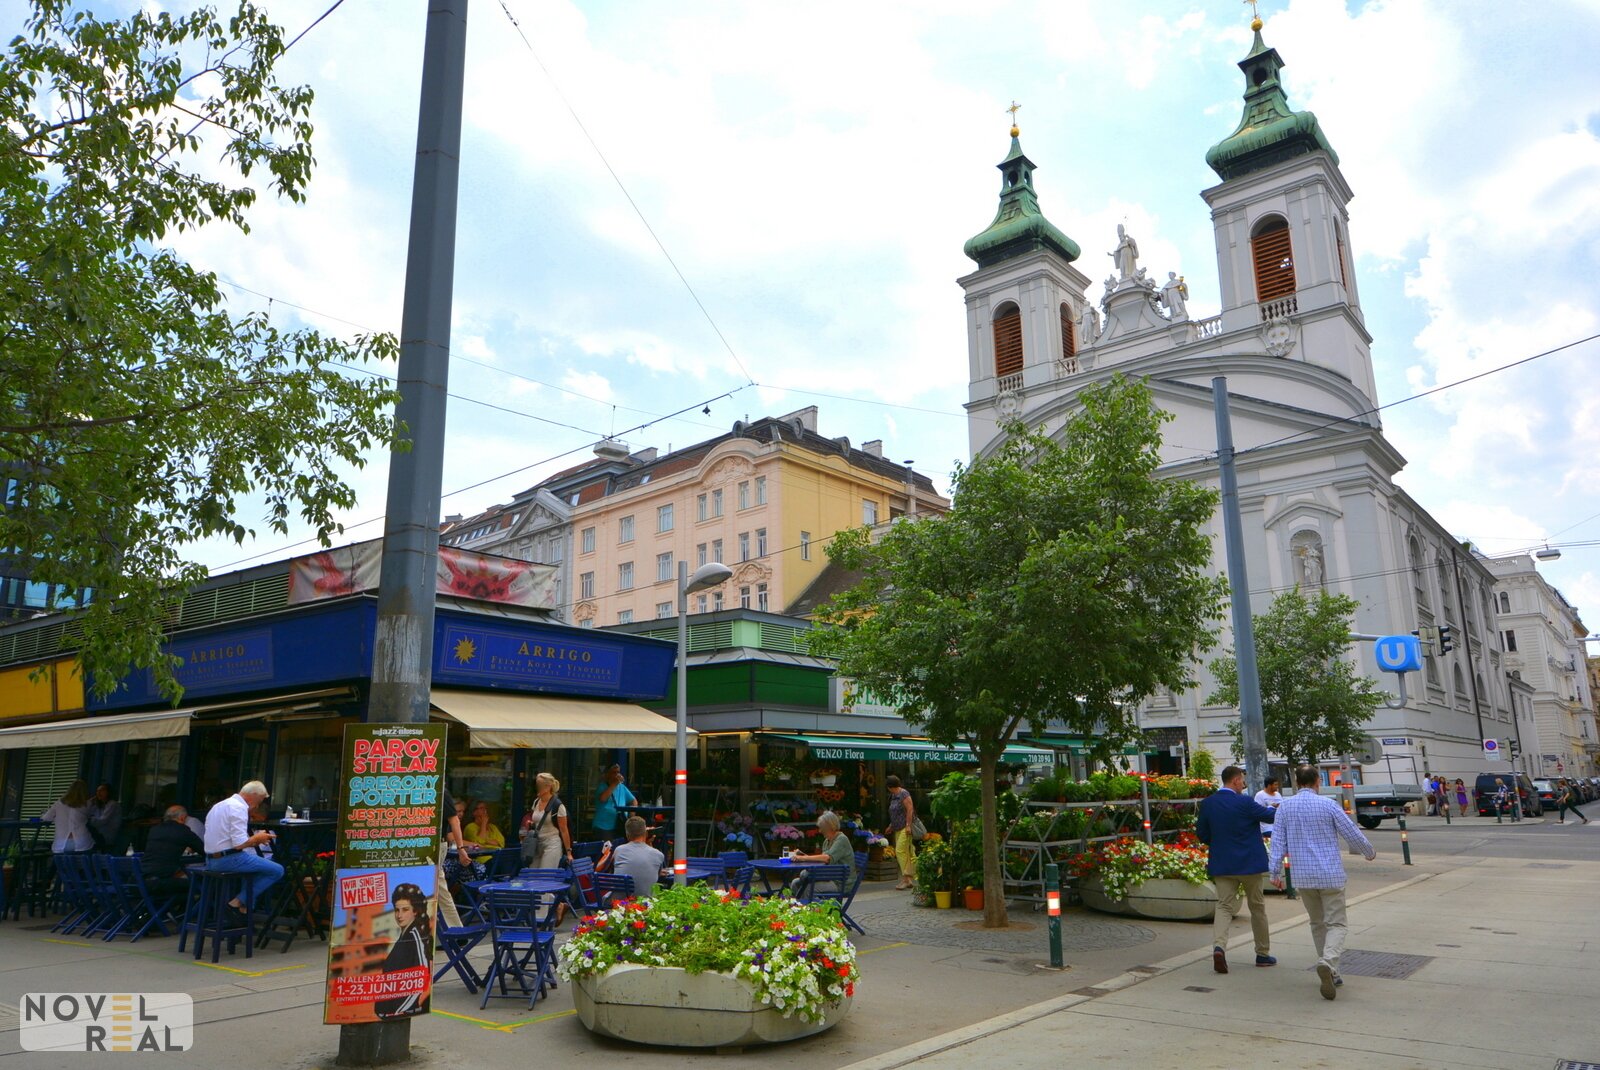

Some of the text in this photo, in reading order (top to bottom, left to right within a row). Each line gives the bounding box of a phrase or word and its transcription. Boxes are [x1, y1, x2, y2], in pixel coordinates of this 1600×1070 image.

[191, 644, 245, 664] ARRIGO
[518, 641, 592, 663] ARRIGO
[1380, 642, 1406, 666] U
[354, 738, 440, 758] PAROV
[816, 748, 865, 760] PENZO Flora
[924, 751, 941, 761] FÜR
[944, 753, 964, 761] HERZ
[967, 754, 979, 762] UN
[353, 756, 438, 773] STELAR
[349, 775, 439, 791] GREGORY
[349, 788, 437, 806] PORTER
[348, 807, 436, 821] JESTOFUNK
[394, 817, 431, 826] ROGERS
[345, 826, 437, 839] THE CAT EMPIRE
[349, 837, 432, 850] FREAK POWER
[393, 850, 416, 859] JUNI
[375, 876, 385, 901] FESTIVAL
[347, 975, 375, 983] ALLEN
[375, 974, 385, 982] 23
[386, 970, 425, 981] BEZIRKEN
[337, 977, 424, 995] 1.-23. JUNI 2018
[335, 995, 360, 1003] EINTRITT
